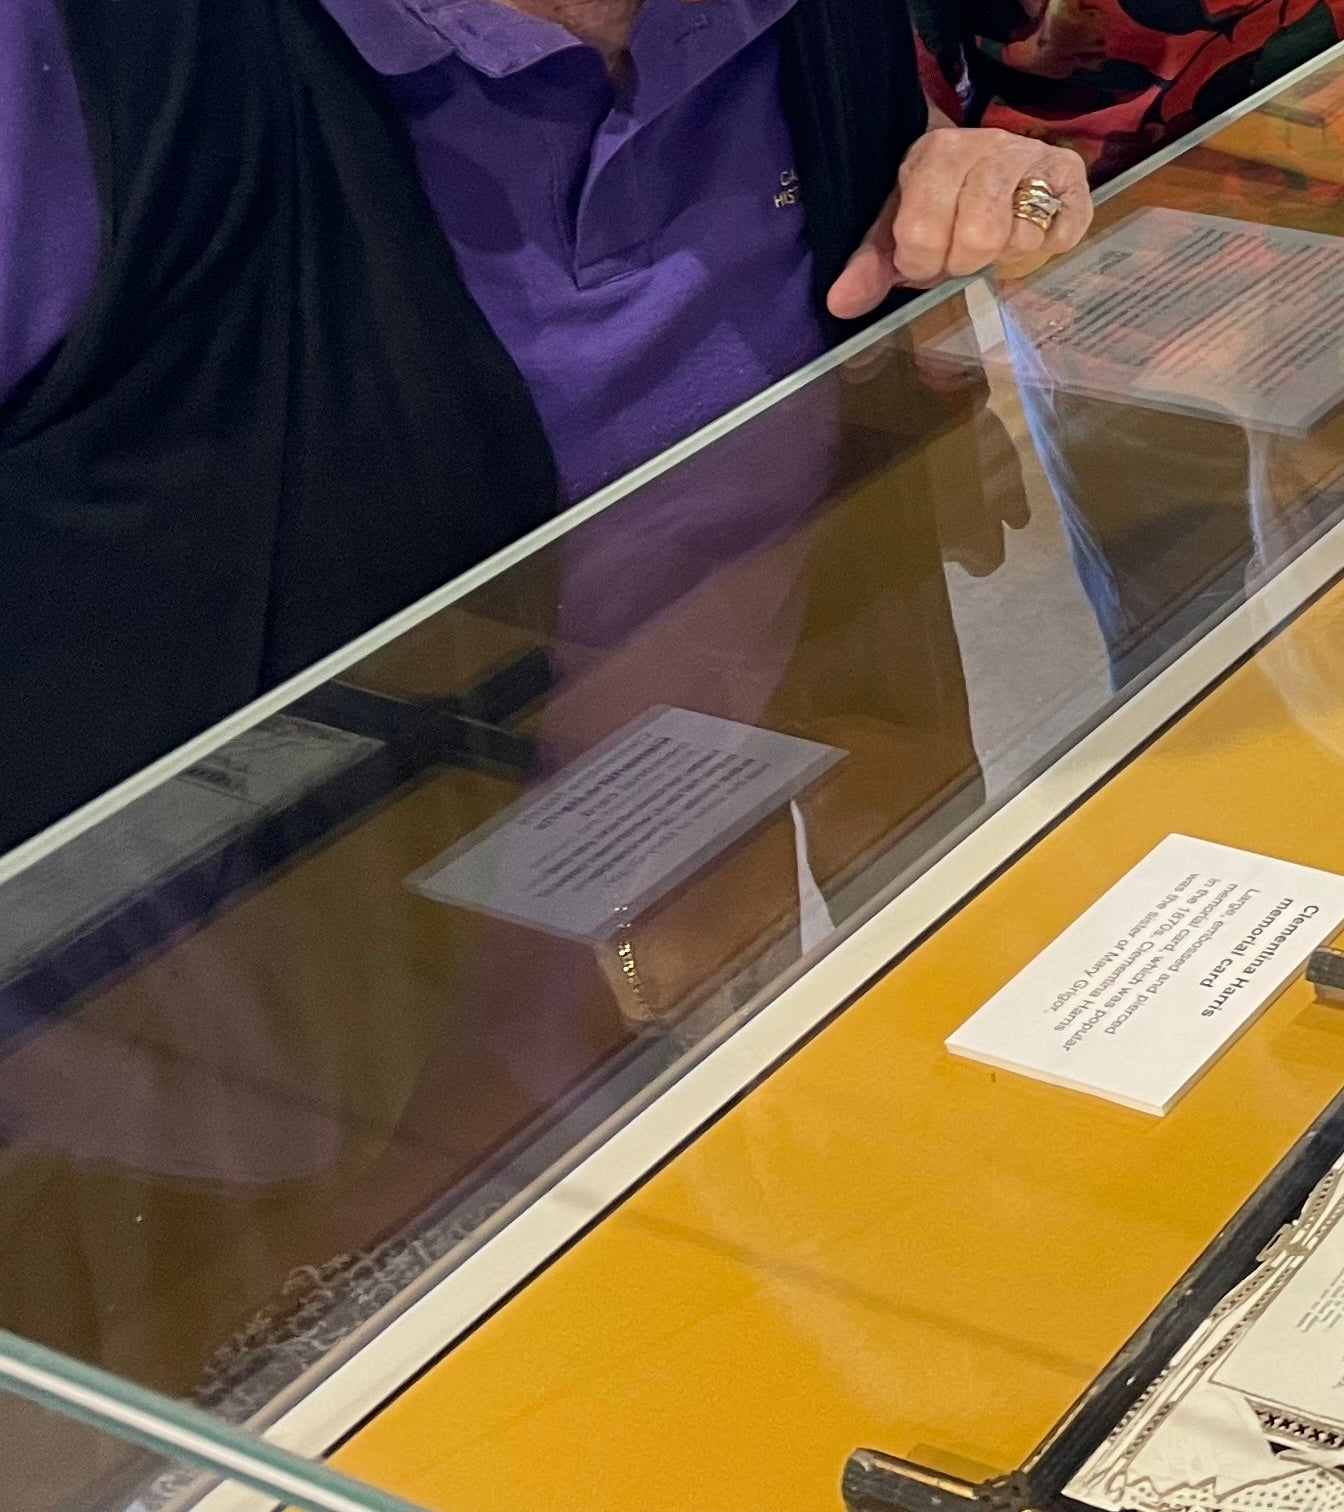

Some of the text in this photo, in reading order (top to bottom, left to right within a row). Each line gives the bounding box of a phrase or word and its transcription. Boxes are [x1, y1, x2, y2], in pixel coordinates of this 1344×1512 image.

[1153, 892, 1179, 910] the
[1171, 871, 1201, 893] was
[1051, 876, 1222, 1033] in the 1870s. Clementina Harris
[1110, 938, 1132, 951] of
[1123, 910, 1161, 939] sister
[1196, 896, 1298, 989] memorial card
[1056, 882, 1242, 1052] memorial card, which was popular
[1080, 949, 1119, 978] Mary
[1100, 886, 1261, 1035] Large, embossed and pierced
[1197, 902, 1323, 1019] Clementina Harris
